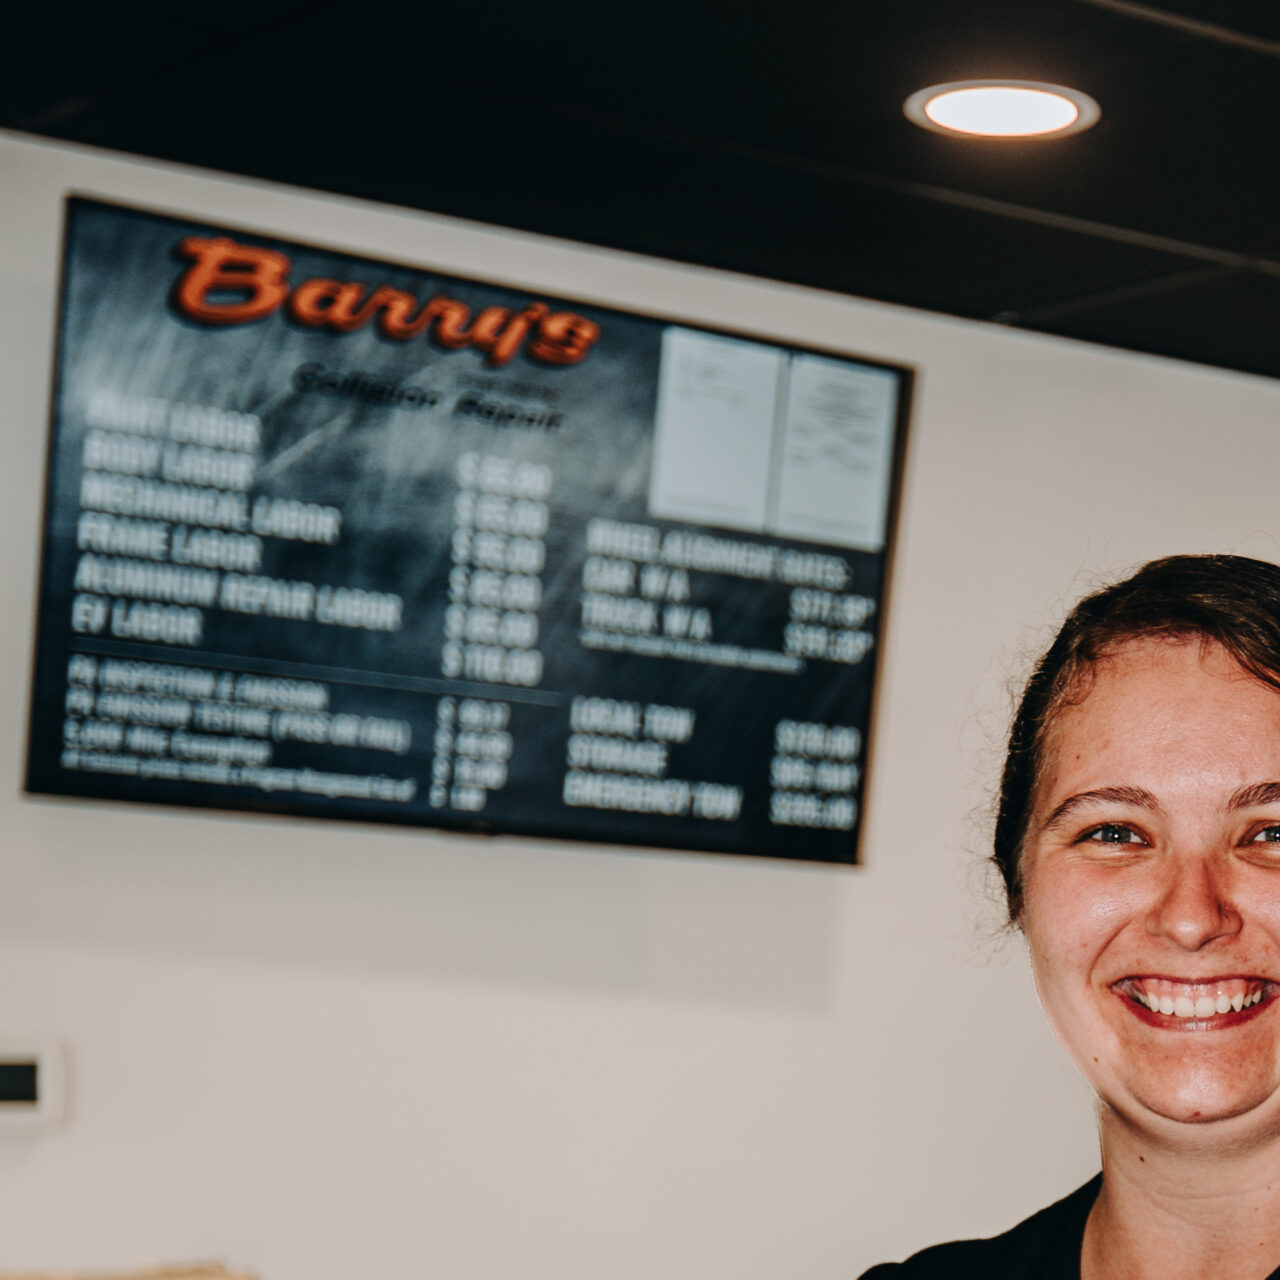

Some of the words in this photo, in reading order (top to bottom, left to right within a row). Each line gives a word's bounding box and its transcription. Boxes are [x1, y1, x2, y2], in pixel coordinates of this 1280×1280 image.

[177, 237, 600, 367] Barry's
[252, 497, 341, 543] LABOR
[172, 525, 261, 571] LABOR
[111, 600, 201, 644] LABOR
[316, 586, 401, 631] LABOR
